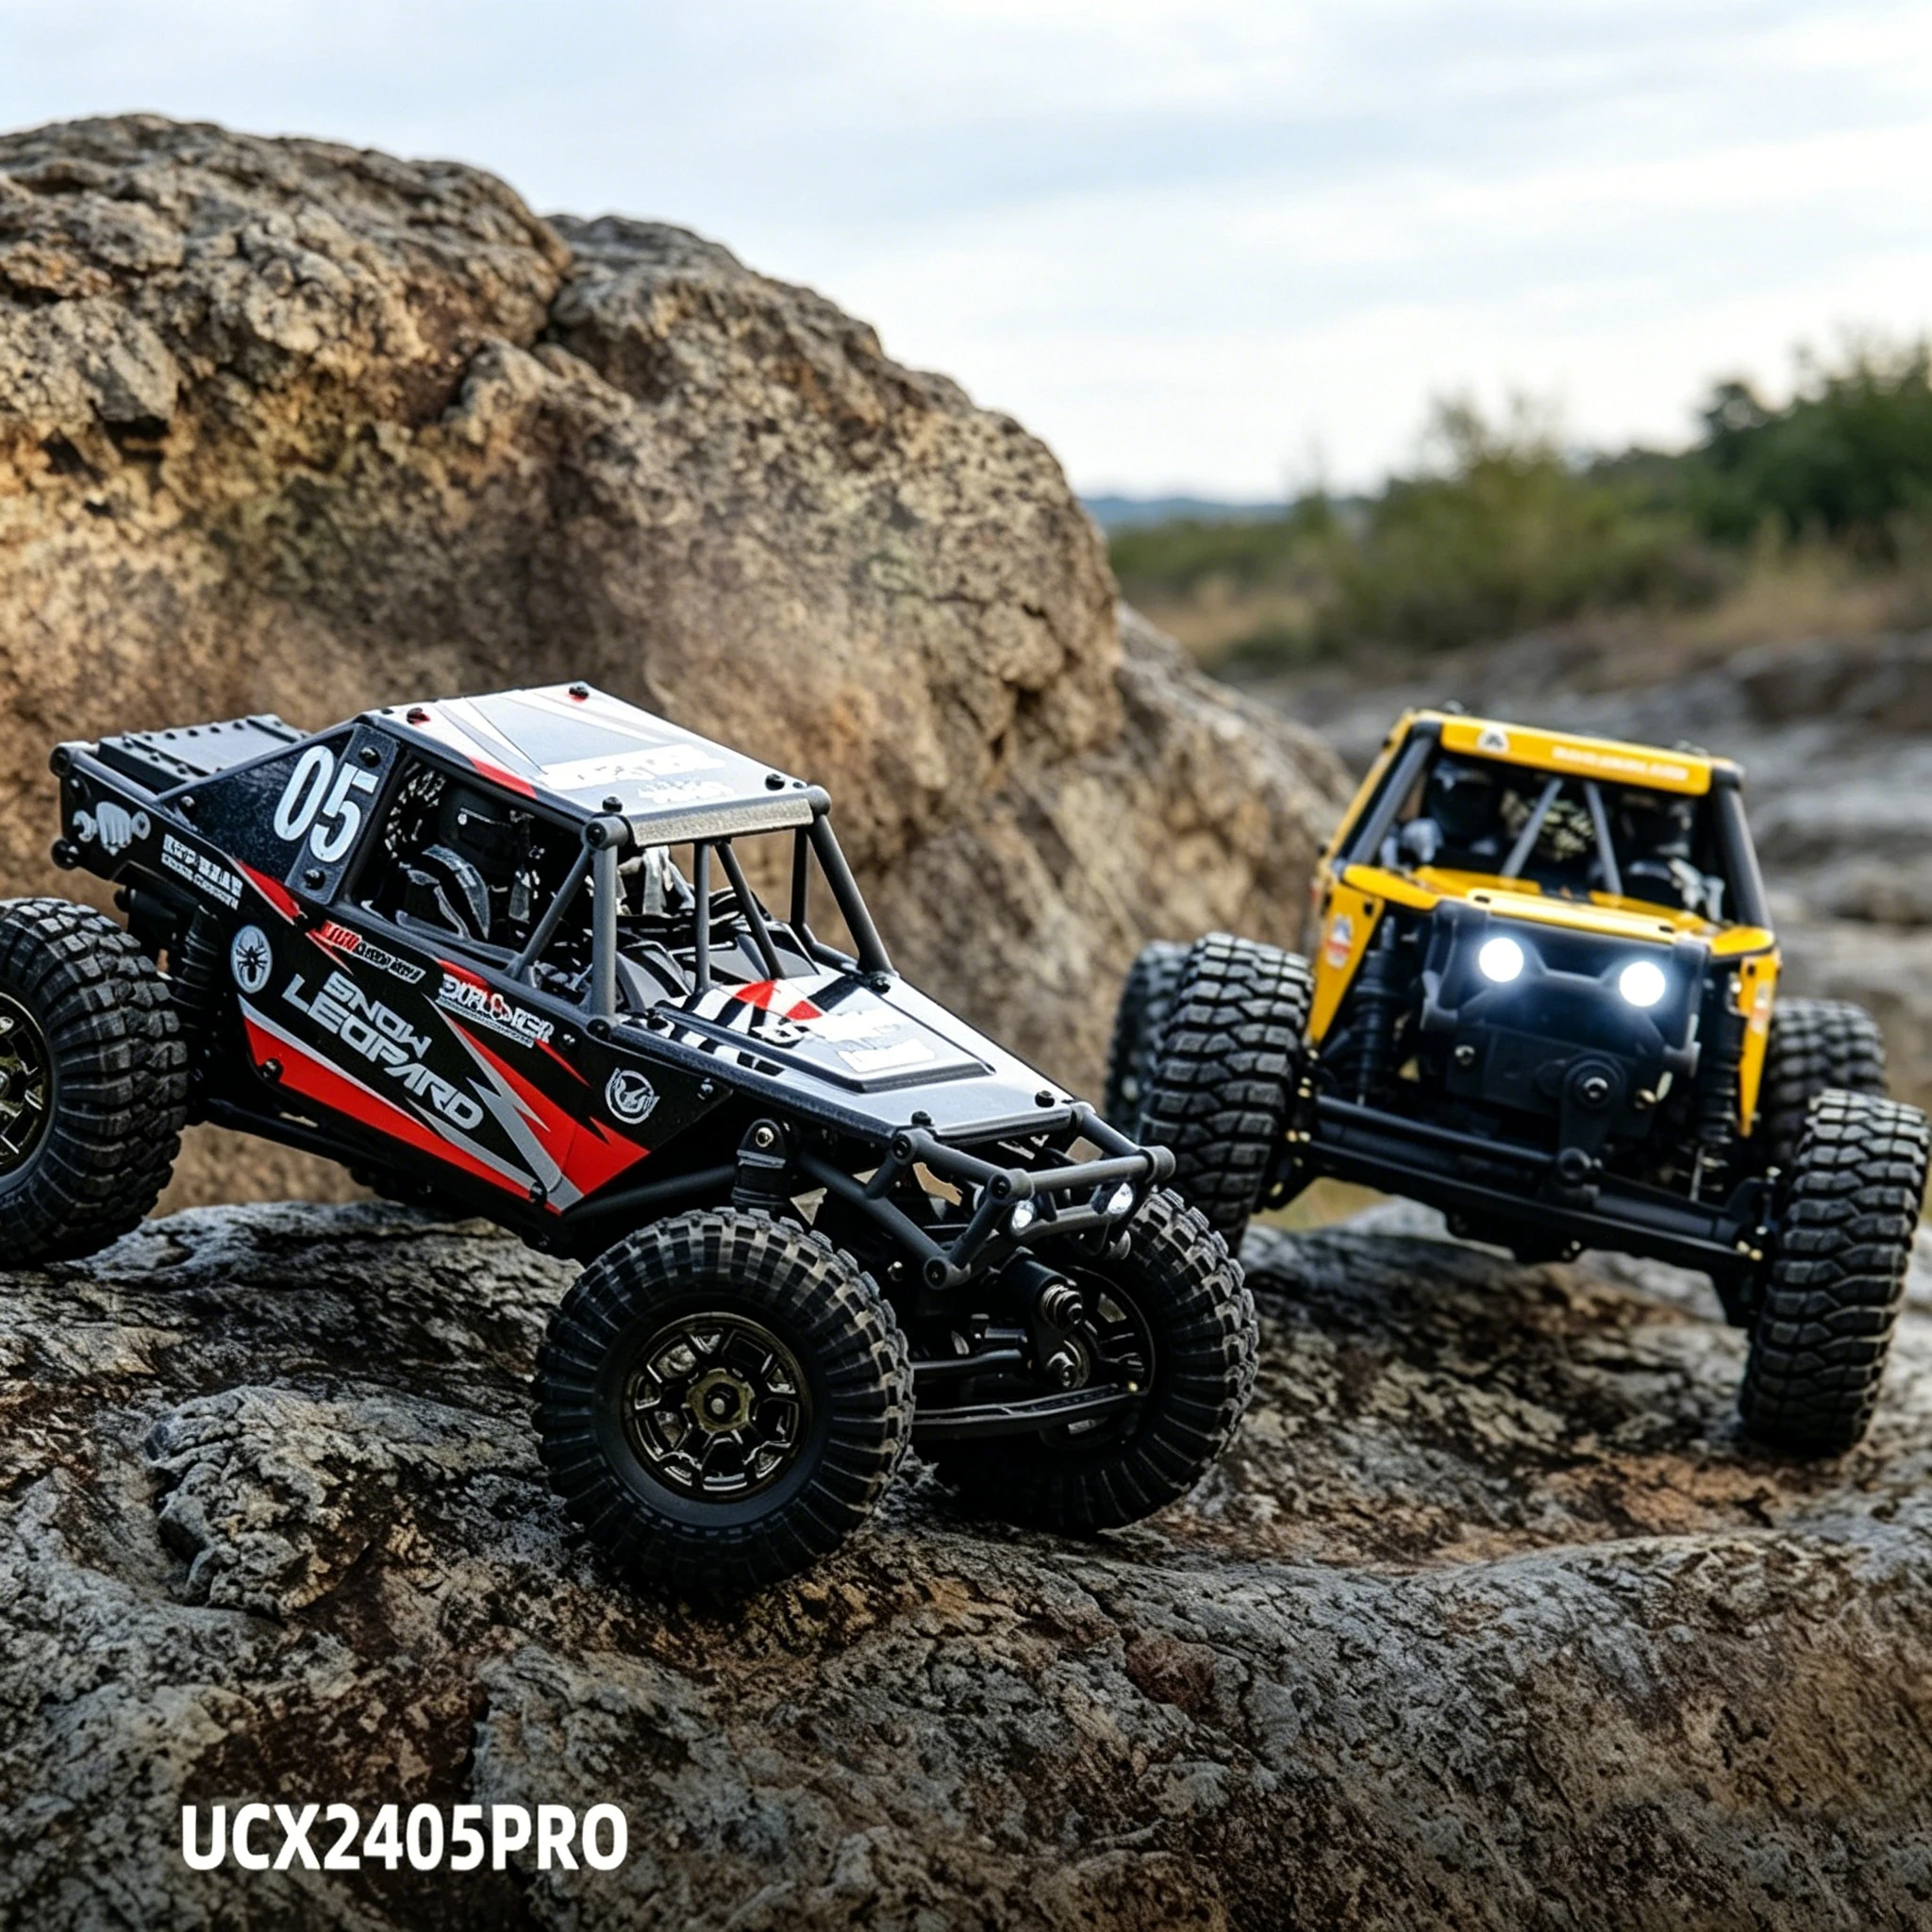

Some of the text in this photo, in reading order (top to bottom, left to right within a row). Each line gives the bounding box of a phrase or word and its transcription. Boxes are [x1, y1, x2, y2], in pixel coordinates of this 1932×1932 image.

[274, 744, 379, 863] 05
[281, 974, 484, 1130] LEOPARD
[323, 971, 432, 1059] SNOW
